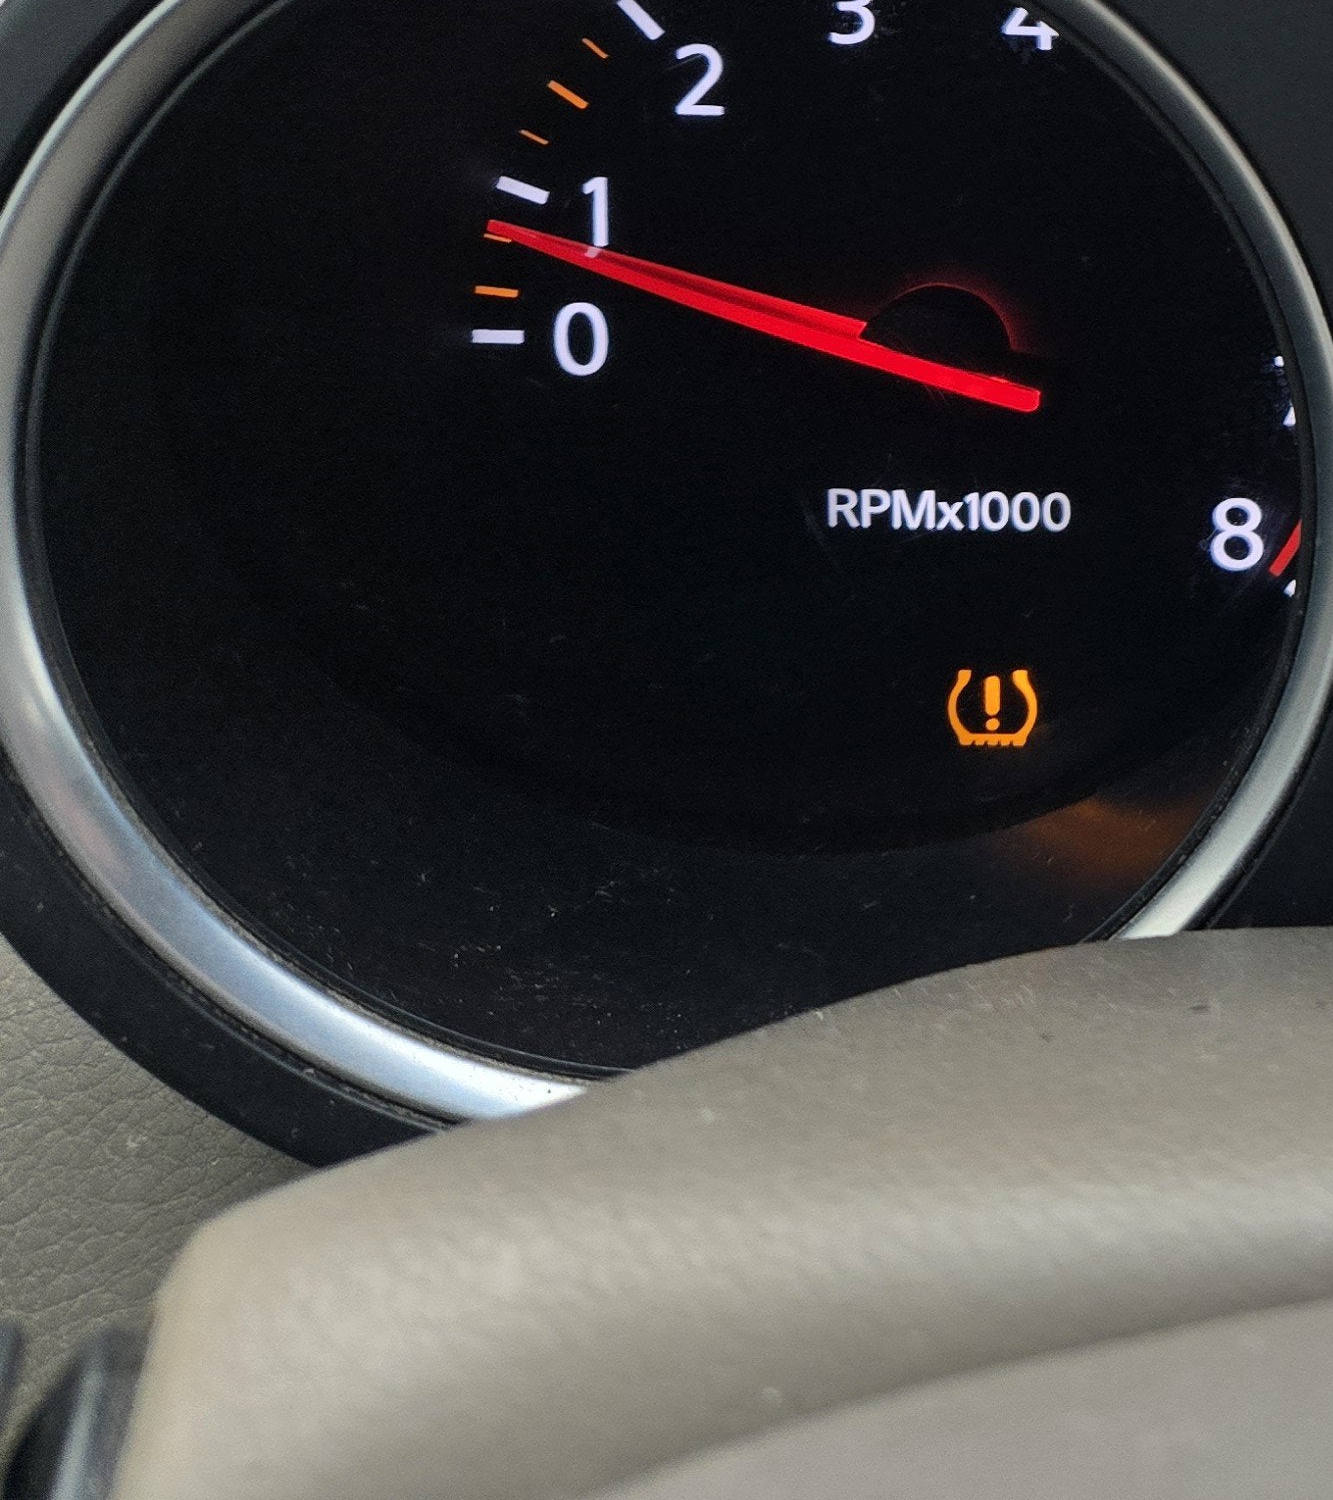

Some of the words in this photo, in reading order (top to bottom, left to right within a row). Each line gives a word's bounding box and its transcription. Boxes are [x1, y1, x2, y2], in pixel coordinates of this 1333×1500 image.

[676, 44, 724, 116] 2
[582, 176, 609, 248] 1
[554, 303, 608, 375] 0
[828, 489, 1070, 531] RPMx1000
[1209, 498, 1264, 571] 8
